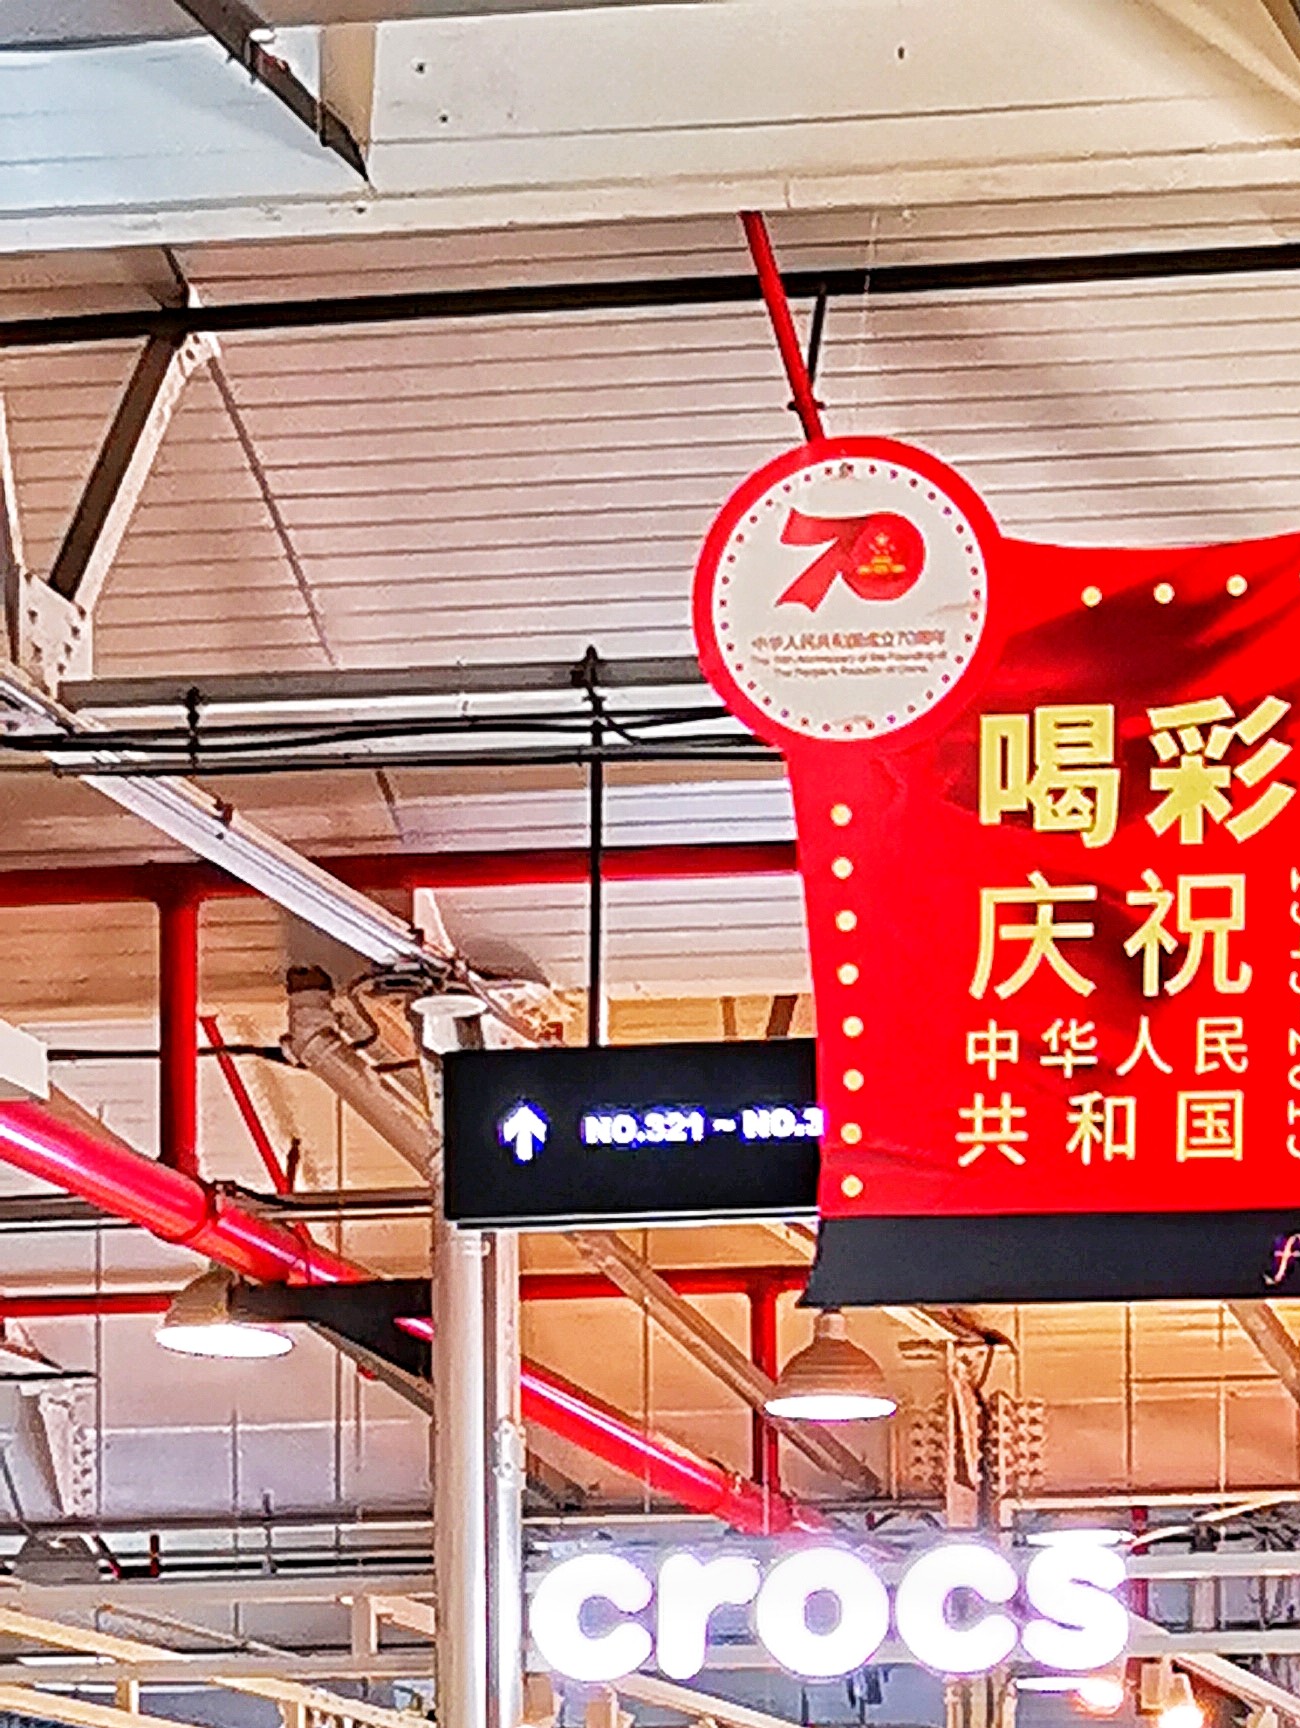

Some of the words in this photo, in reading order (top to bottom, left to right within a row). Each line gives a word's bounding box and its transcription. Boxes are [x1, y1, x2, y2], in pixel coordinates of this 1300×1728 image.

[967, 867, 1254, 1001] 庆祝
[965, 1014, 1250, 1081] 中华人民
[954, 1088, 1246, 1167] 共和国
[527, 1542, 1132, 1684] crocs
